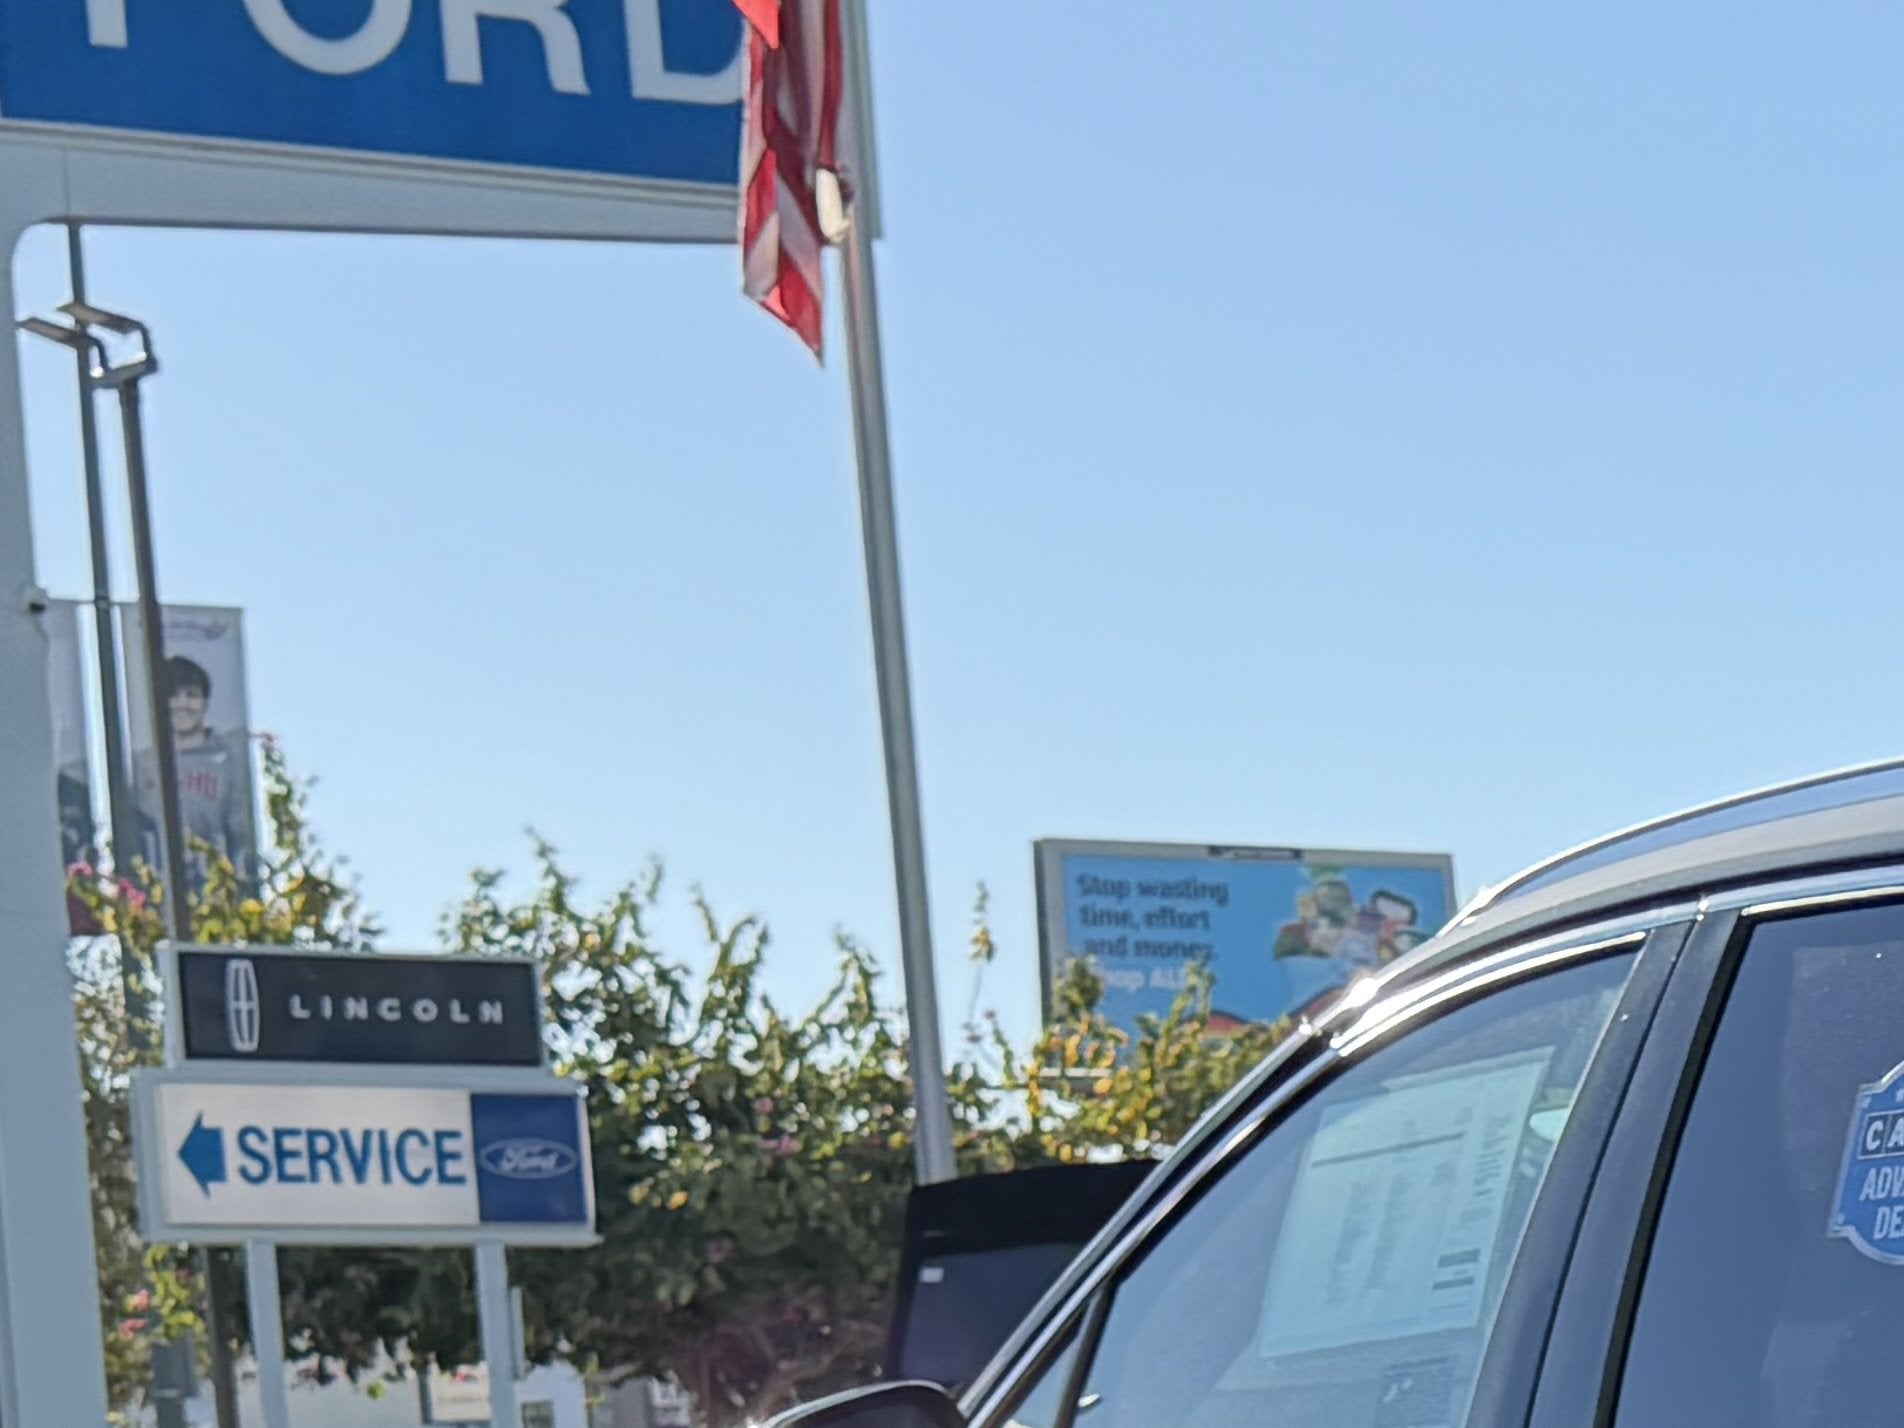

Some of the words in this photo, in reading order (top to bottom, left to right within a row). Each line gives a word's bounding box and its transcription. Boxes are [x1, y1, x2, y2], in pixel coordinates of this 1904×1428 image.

[1077, 873, 1131, 900] Stop
[1136, 874, 1229, 907] wasting
[1144, 905, 1211, 929] effort
[1084, 935, 1128, 957] and
[289, 994, 504, 1026] LINCOLN
[236, 1125, 467, 1187] SERVICE
